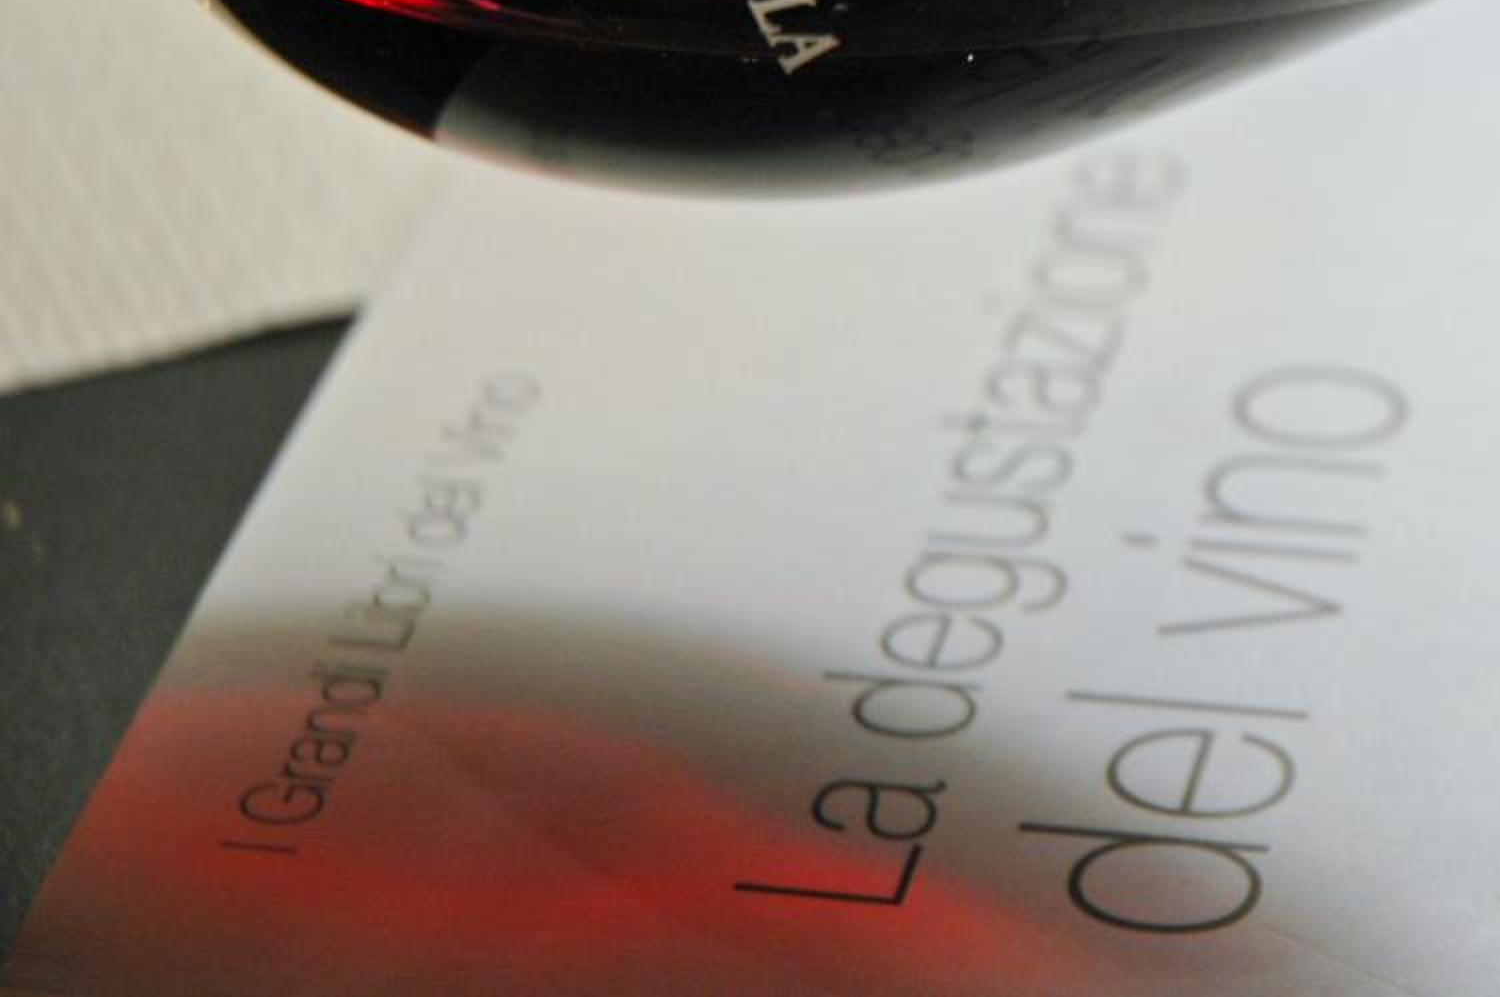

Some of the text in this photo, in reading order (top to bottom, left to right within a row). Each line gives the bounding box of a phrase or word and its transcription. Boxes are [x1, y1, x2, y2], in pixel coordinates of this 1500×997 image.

[238, 662, 388, 826] Grandi
[327, 552, 446, 651] Libri
[733, 147, 1190, 906] La degustazione
[1018, 363, 1412, 935] del vino
